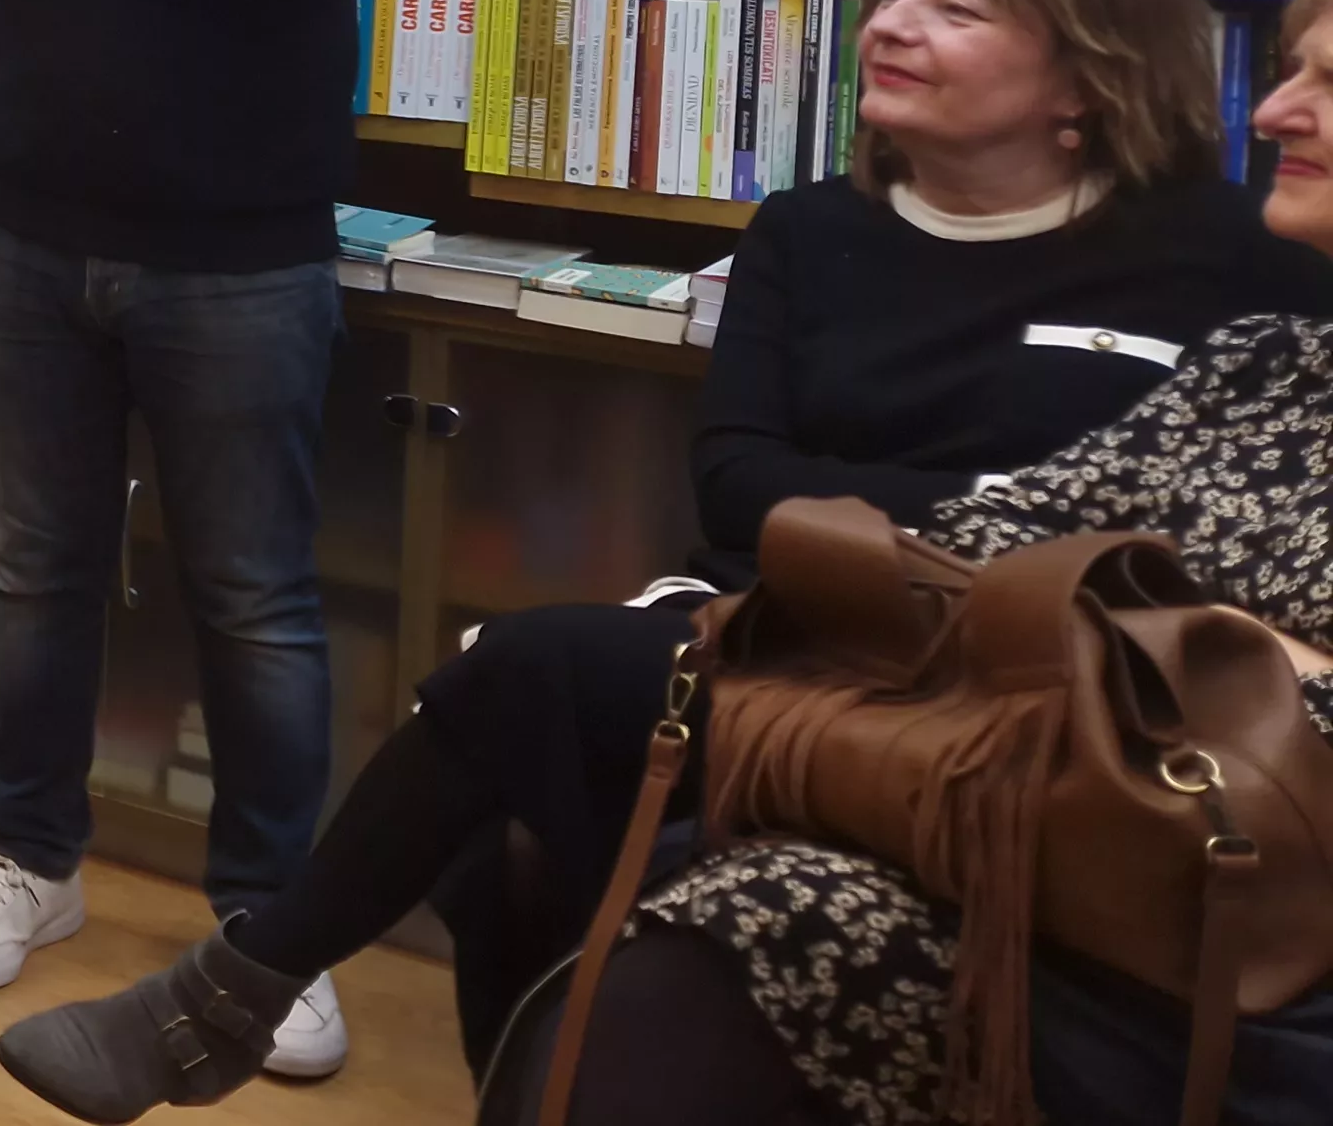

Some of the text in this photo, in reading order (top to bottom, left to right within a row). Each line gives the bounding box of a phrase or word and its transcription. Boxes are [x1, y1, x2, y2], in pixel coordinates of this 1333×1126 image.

[744, 36, 755, 54] TUS
[684, 75, 700, 132] DIGNIDAD
[741, 55, 753, 100] SOMBRAS
[511, 96, 529, 168] ALBERT ESPINOSA
[527, 97, 548, 170] ALBERT ESPINOSA
